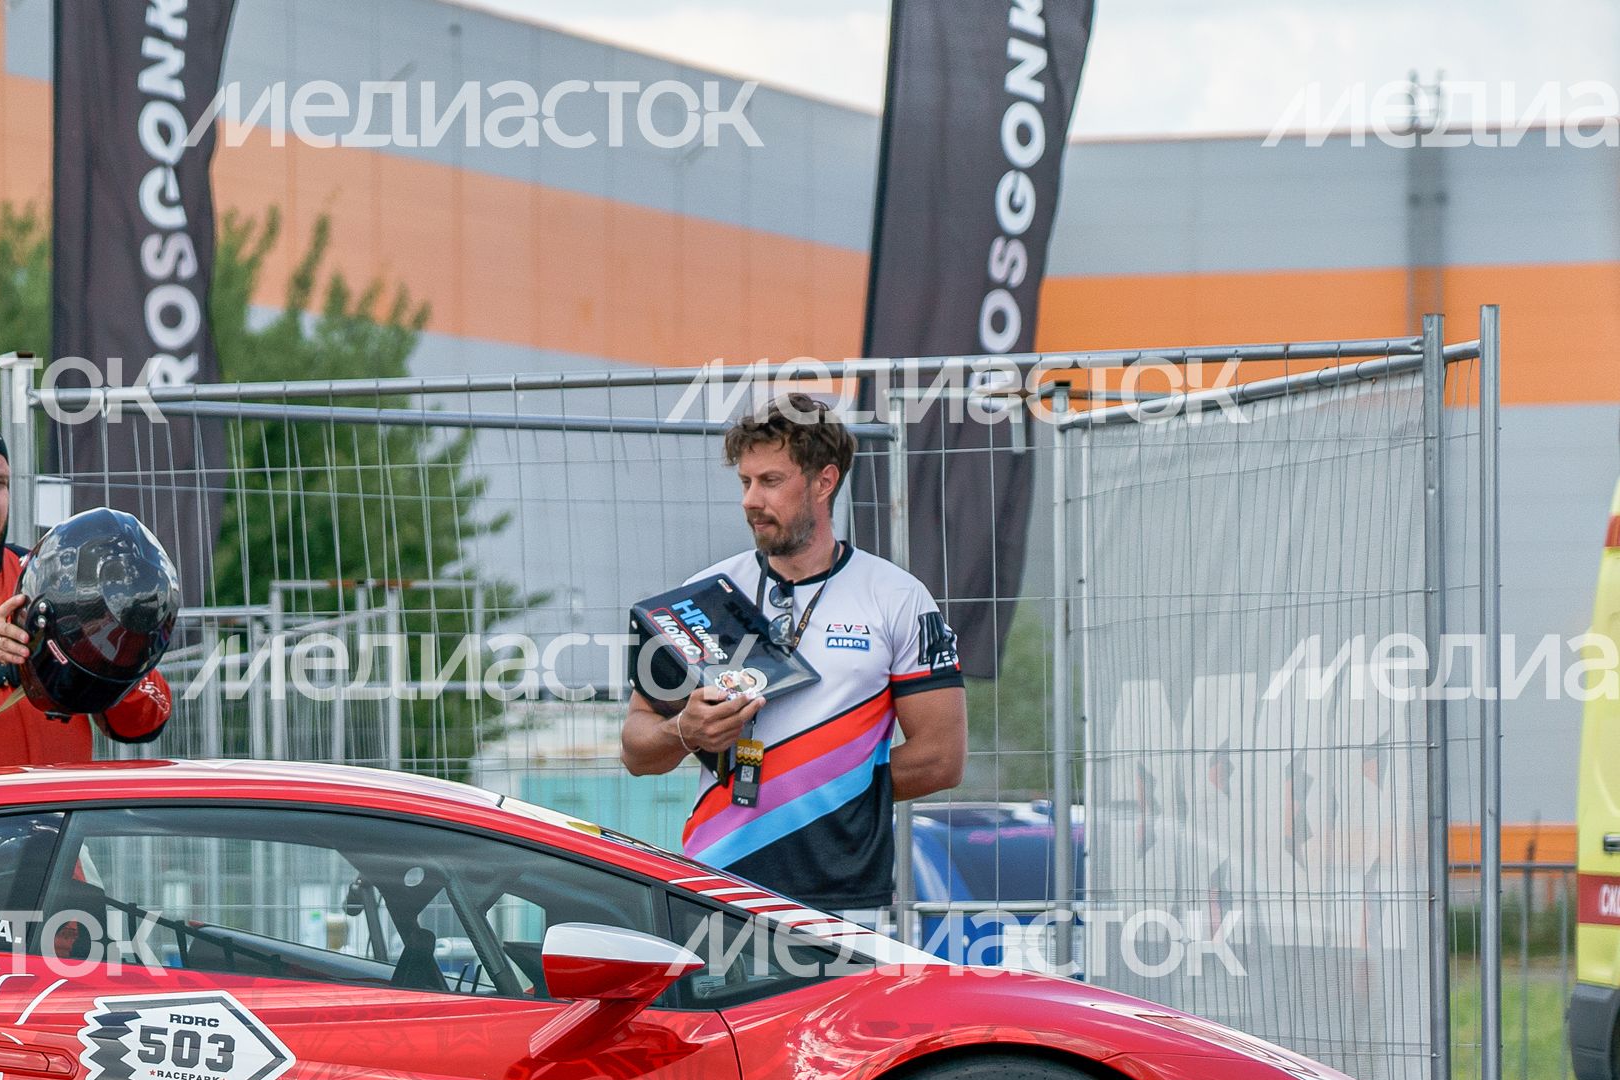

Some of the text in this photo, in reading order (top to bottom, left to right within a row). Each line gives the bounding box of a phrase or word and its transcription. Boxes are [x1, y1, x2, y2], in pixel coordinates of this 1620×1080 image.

[827, 637, 870, 650] AIMOL
[169, 1013, 219, 1028] RDRC
[137, 1025, 235, 1073] 503
